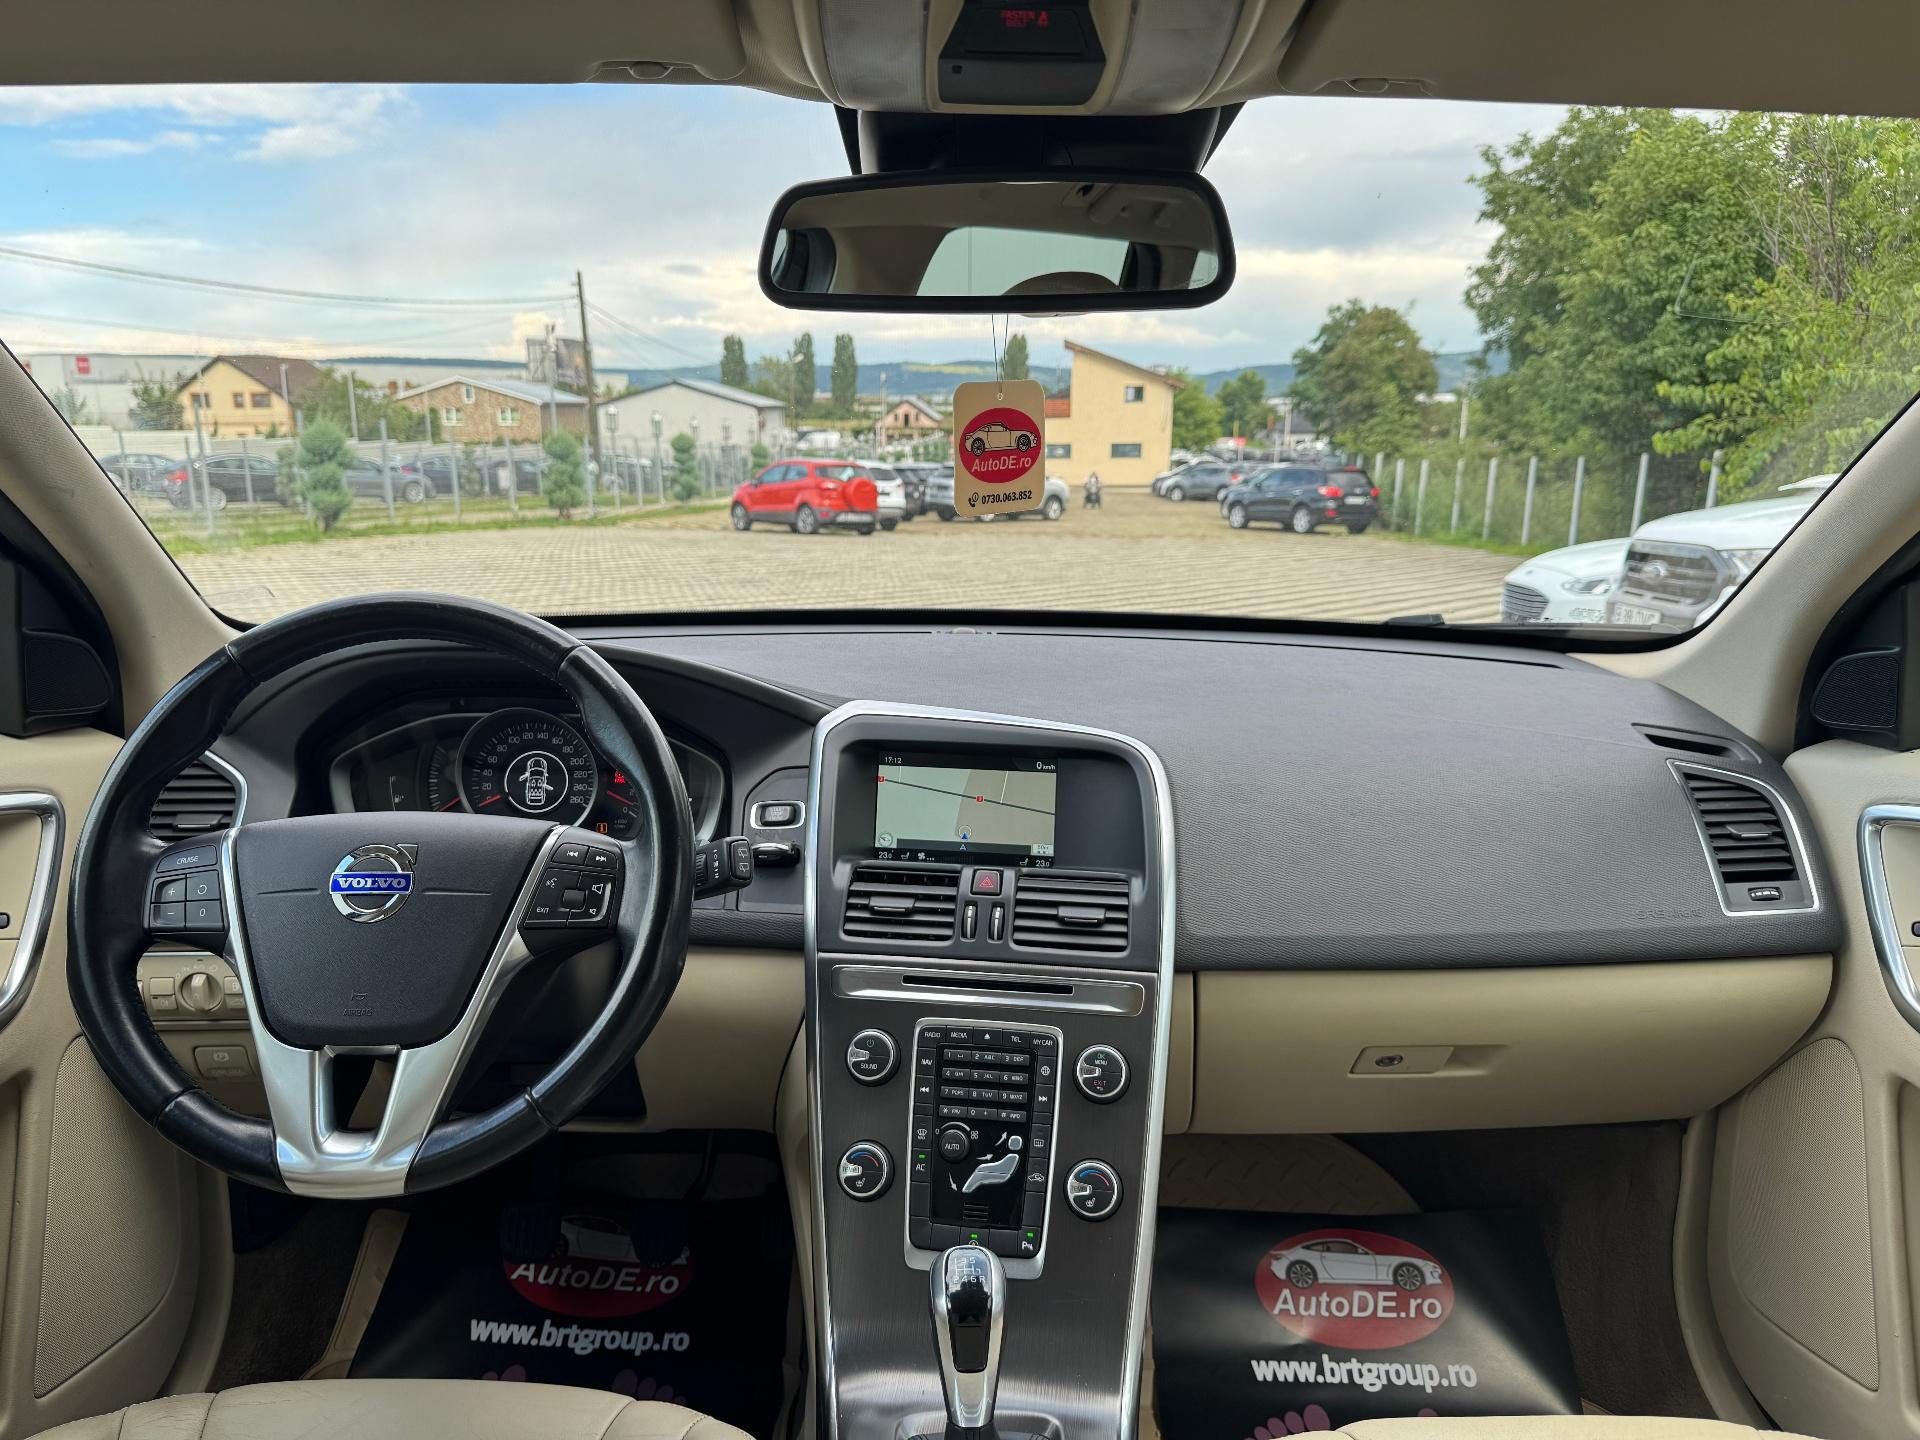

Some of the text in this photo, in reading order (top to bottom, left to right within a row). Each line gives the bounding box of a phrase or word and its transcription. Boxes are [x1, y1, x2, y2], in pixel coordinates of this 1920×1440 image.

[971, 455, 1032, 473] AutoDE.ro
[981, 490, 1033, 505] 0730.063.852
[508, 736, 521, 744] 100
[496, 744, 508, 752] 80
[562, 745, 574, 753] 180
[487, 755, 498, 763] 60
[570, 757, 585, 765] 200
[885, 756, 902, 764] 17:12
[1036, 761, 1042, 770] 0
[573, 770, 588, 778] 220
[481, 782, 492, 790] 20
[573, 783, 588, 791] 240
[569, 796, 584, 804] 260
[176, 855, 199, 865] CRUISE
[336, 877, 407, 889] VOLVO
[536, 906, 550, 914] EXIT
[1010, 1035, 1022, 1043] TEL
[860, 1062, 878, 1070] SOUND
[920, 1058, 933, 1066] NAV
[1094, 1079, 1107, 1087] EXIT
[944, 1142, 960, 1151] AUTO
[915, 1163, 926, 1171] AC
[969, 1256, 976, 1264] 5
[510, 1263, 680, 1295] AutoDE.ro
[961, 1275, 968, 1283] 4
[970, 1275, 977, 1283] 6
[979, 1275, 986, 1284] R
[1273, 1289, 1442, 1320] AutoDE.ro
[470, 1317, 691, 1356] www.brtgroup.ro
[1250, 1353, 1478, 1393] www.brtgroup.ro
